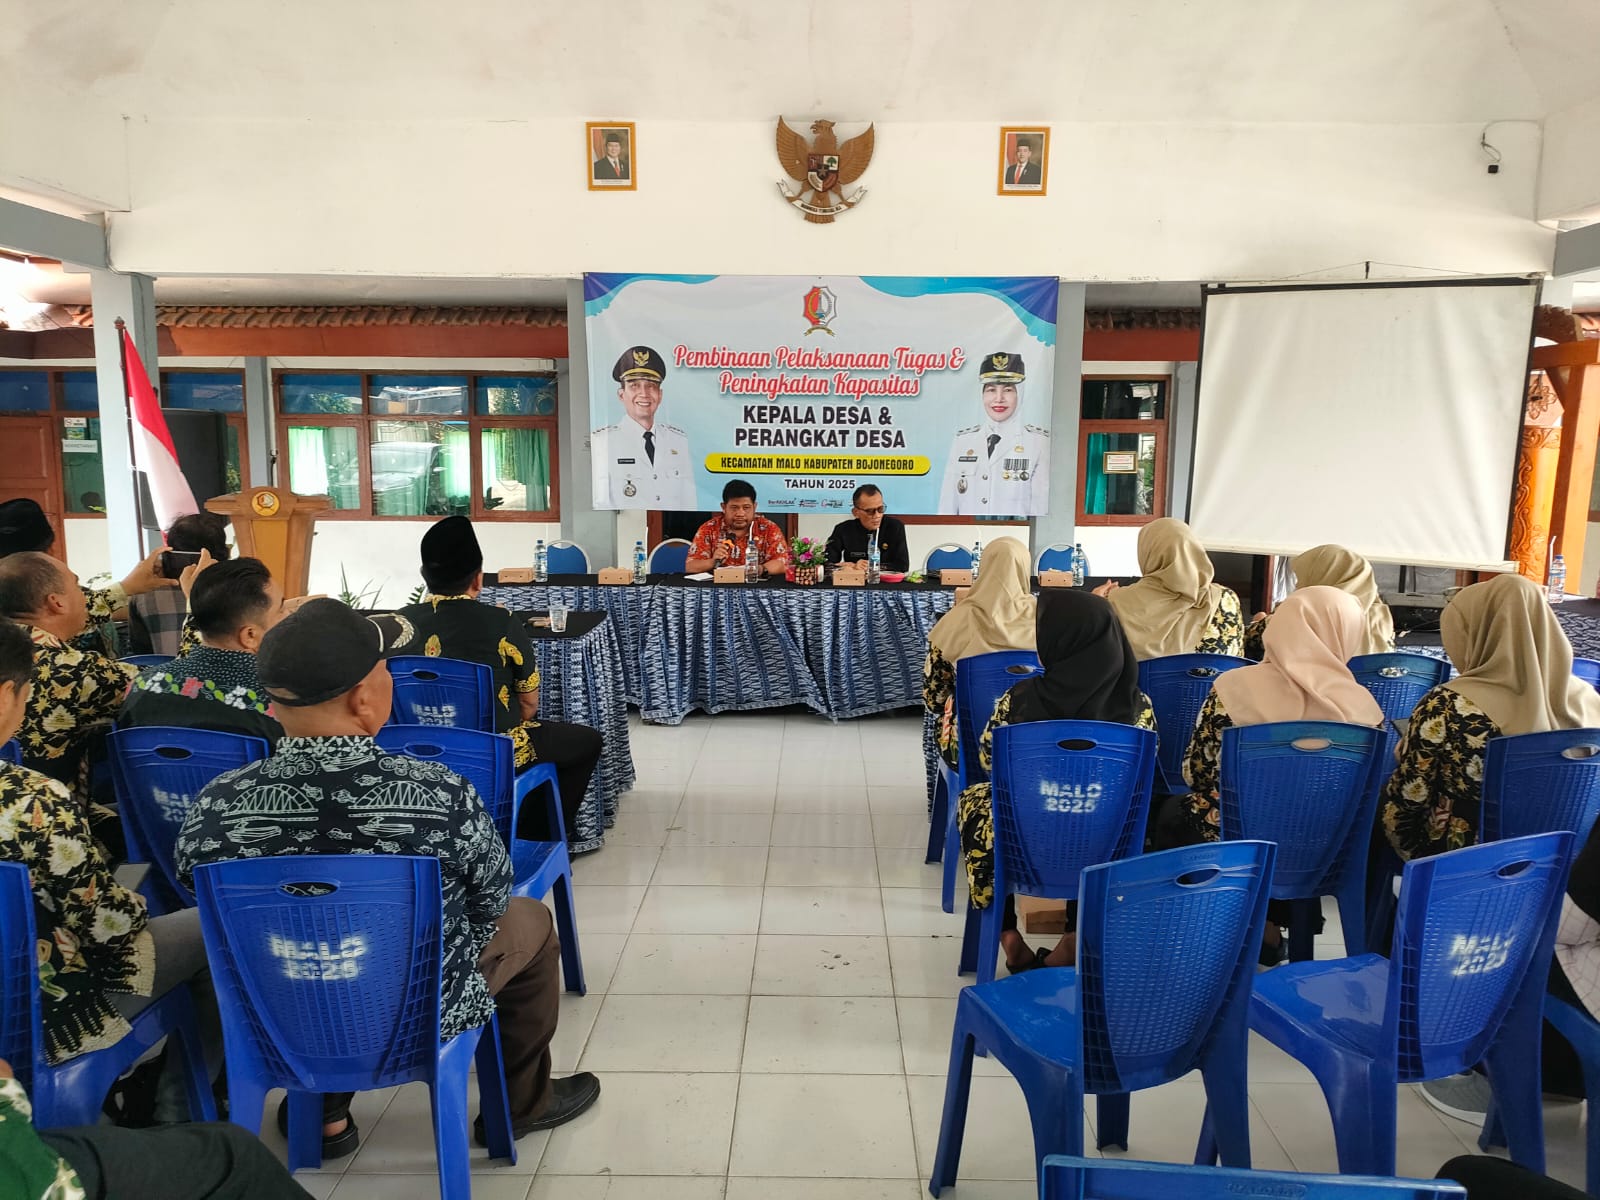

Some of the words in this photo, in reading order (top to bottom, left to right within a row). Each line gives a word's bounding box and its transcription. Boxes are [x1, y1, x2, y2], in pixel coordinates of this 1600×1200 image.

[674, 345, 771, 368] Pembinaan
[776, 347, 890, 369] Pelaksanaan
[893, 347, 945, 374] Tugas
[949, 347, 965, 370] &
[719, 371, 829, 400] Peningkatan
[833, 373, 920, 400] Kapasitas
[743, 405, 816, 424] KEPALA
[822, 406, 872, 425] DESA
[878, 406, 892, 425] &
[735, 428, 850, 447] PERANGKAT
[855, 430, 906, 448] DESA
[721, 457, 773, 468] KECAMATAN
[776, 458, 801, 469] MALO
[804, 458, 853, 470] KABUPATEN
[856, 459, 914, 470] BOJONEGORO
[784, 479, 825, 489] TAHUN
[828, 479, 856, 489] 2025
[1040, 780, 1103, 798] MALO
[269, 934, 367, 960] MALO
